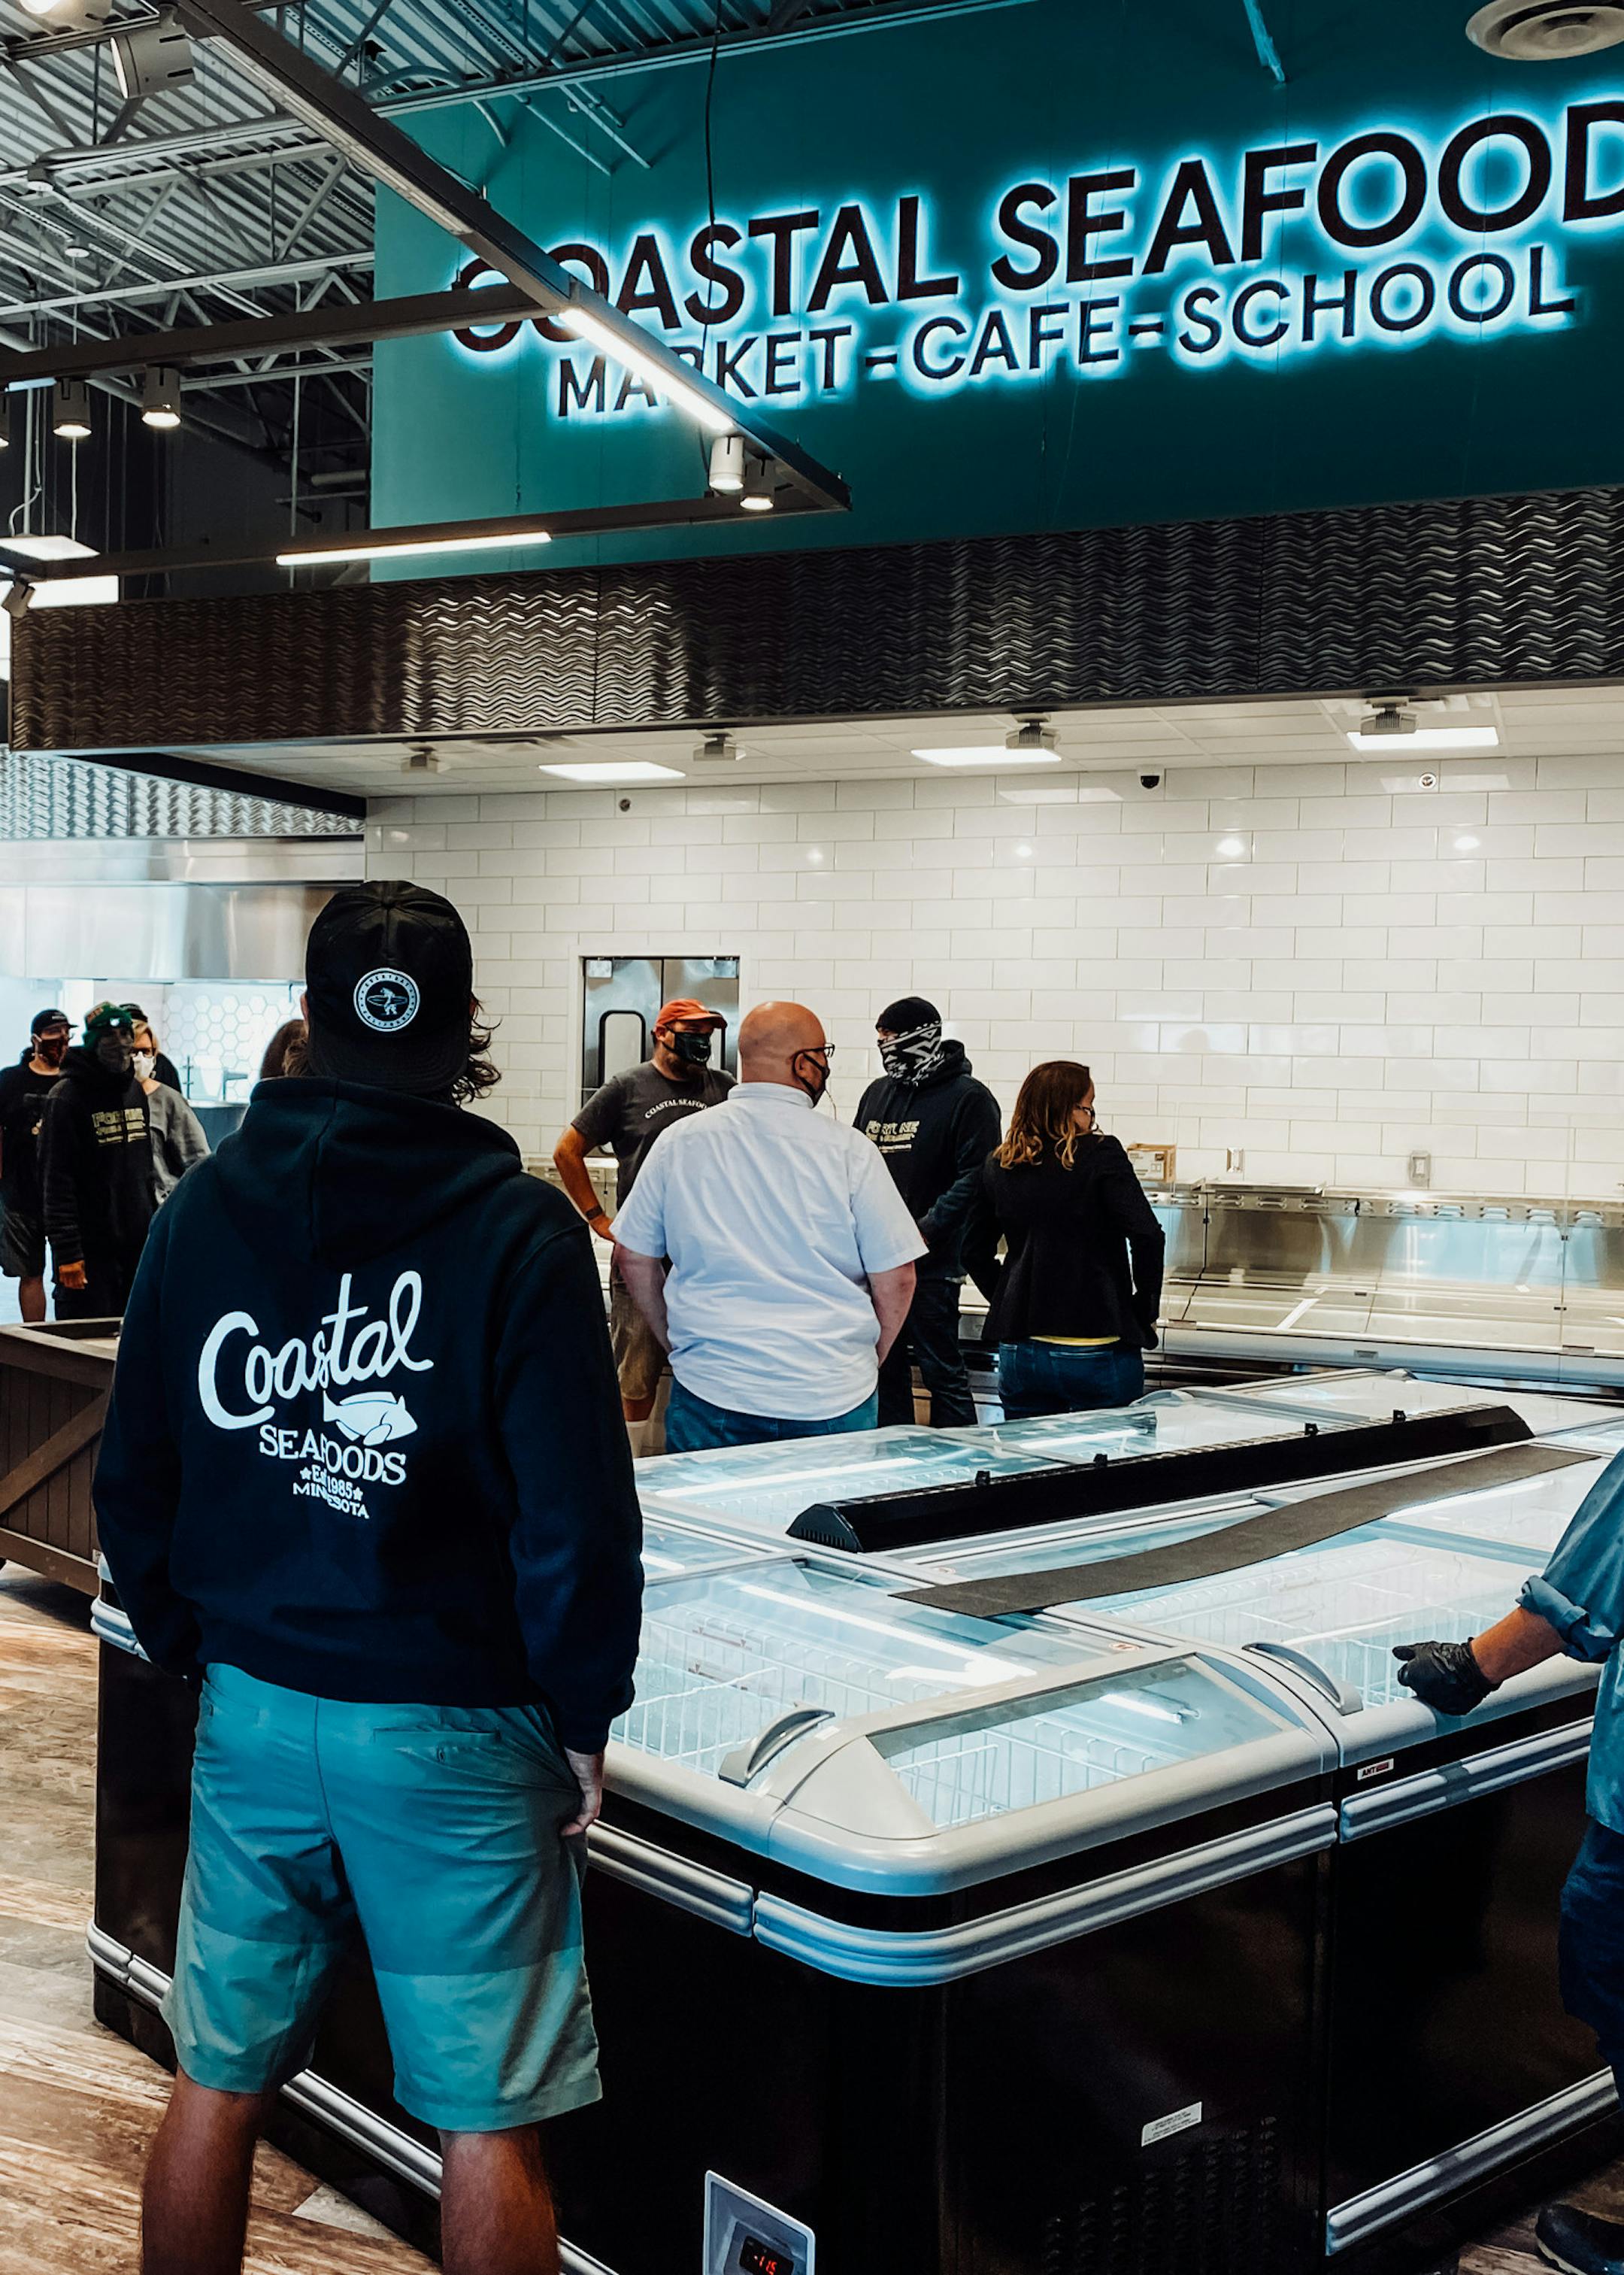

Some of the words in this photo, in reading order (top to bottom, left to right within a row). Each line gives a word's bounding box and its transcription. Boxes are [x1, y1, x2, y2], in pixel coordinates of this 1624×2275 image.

[991, 99, 1624, 290] SEAFOOD
[913, 296, 1120, 380] CAFE
[1178, 245, 1575, 354] SCHOOL
[644, 1099, 678, 1119] COASTAL
[198, 1270, 434, 1430] Coastal
[259, 1424, 407, 1485] SEAFOODS
[326, 1476, 353, 1500] 1985
